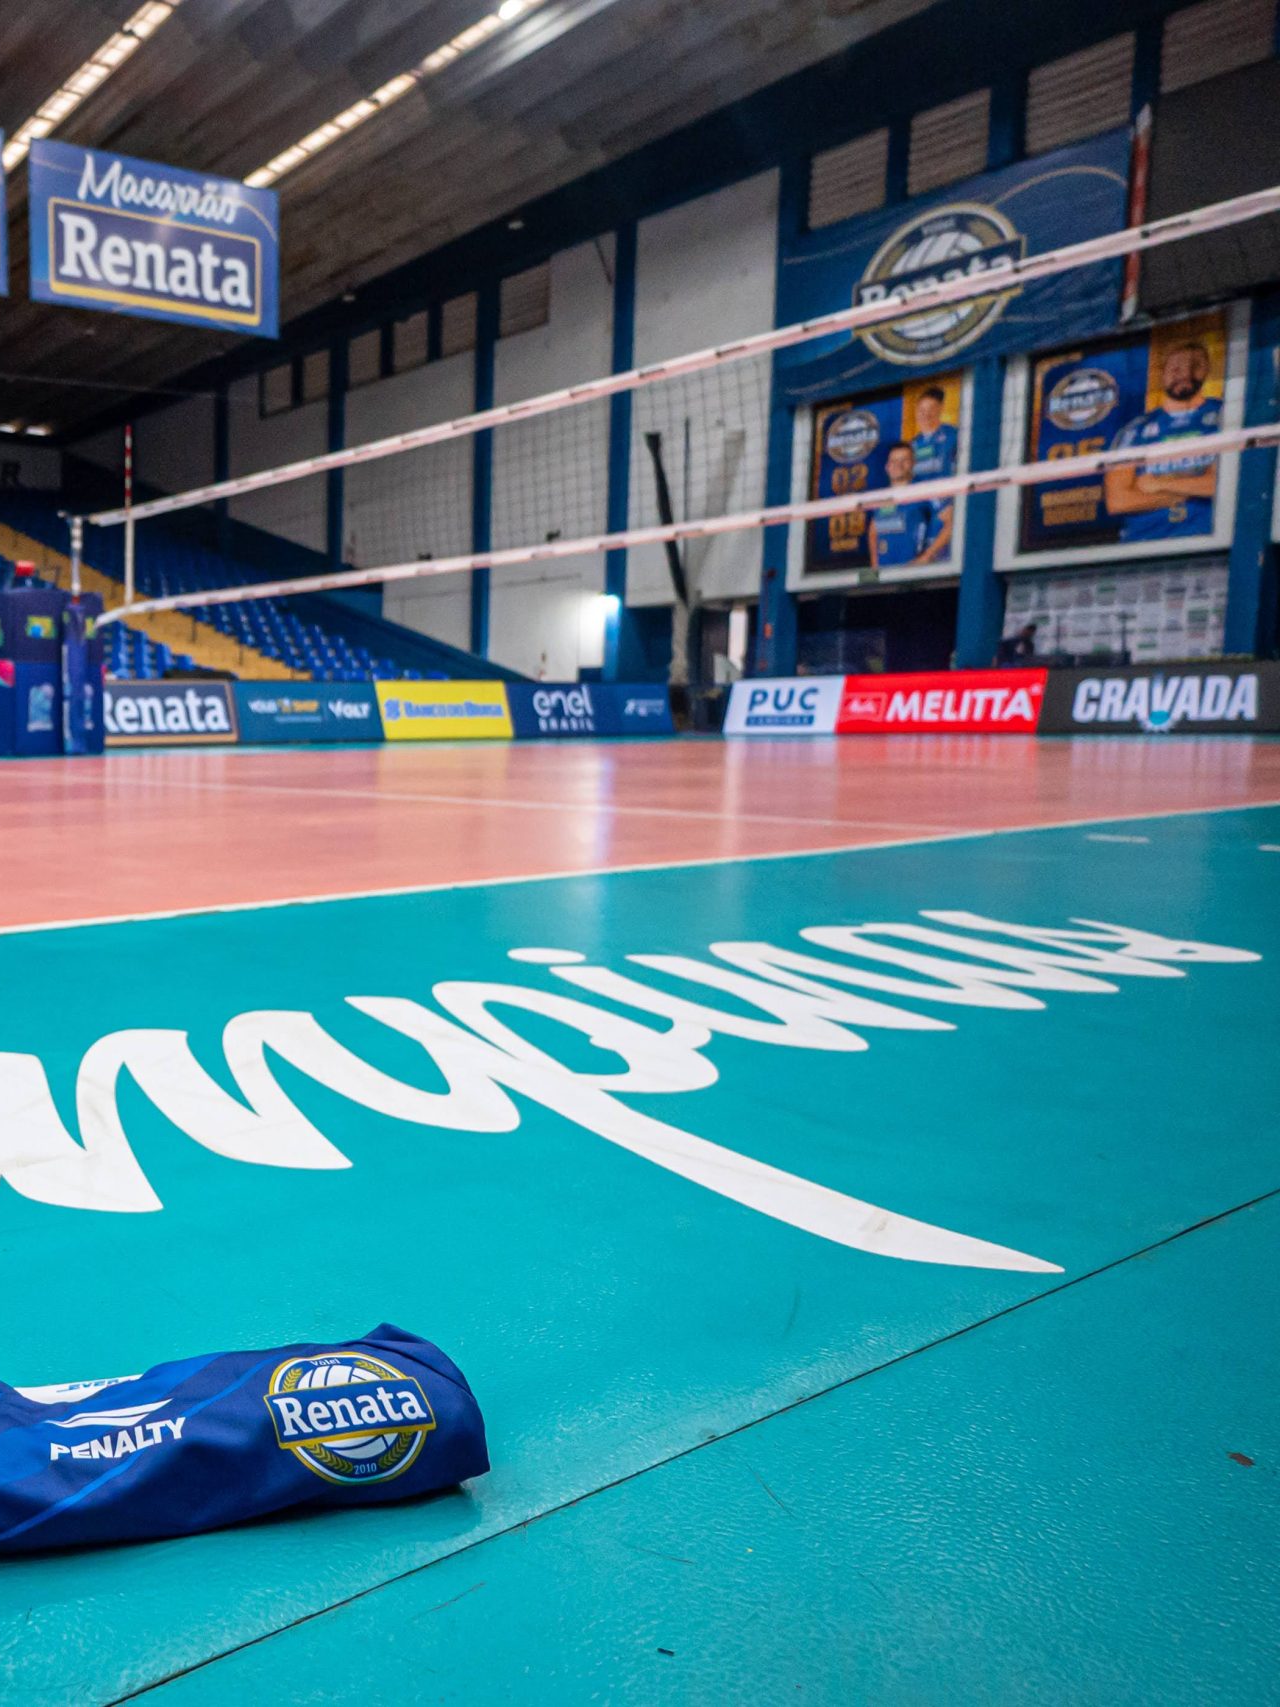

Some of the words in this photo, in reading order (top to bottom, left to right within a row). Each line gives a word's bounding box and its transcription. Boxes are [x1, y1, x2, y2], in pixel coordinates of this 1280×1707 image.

[77, 154, 244, 224] Macarrão
[59, 212, 250, 307] Renata
[533, 685, 594, 717] enel
[749, 687, 819, 711] PUC
[885, 688, 1033, 721] MELITTA
[1072, 675, 1258, 725] CRAVADA
[273, 1387, 427, 1436] Renata
[50, 1417, 186, 1461] PENALTY
[354, 1463, 377, 1475] 2010
